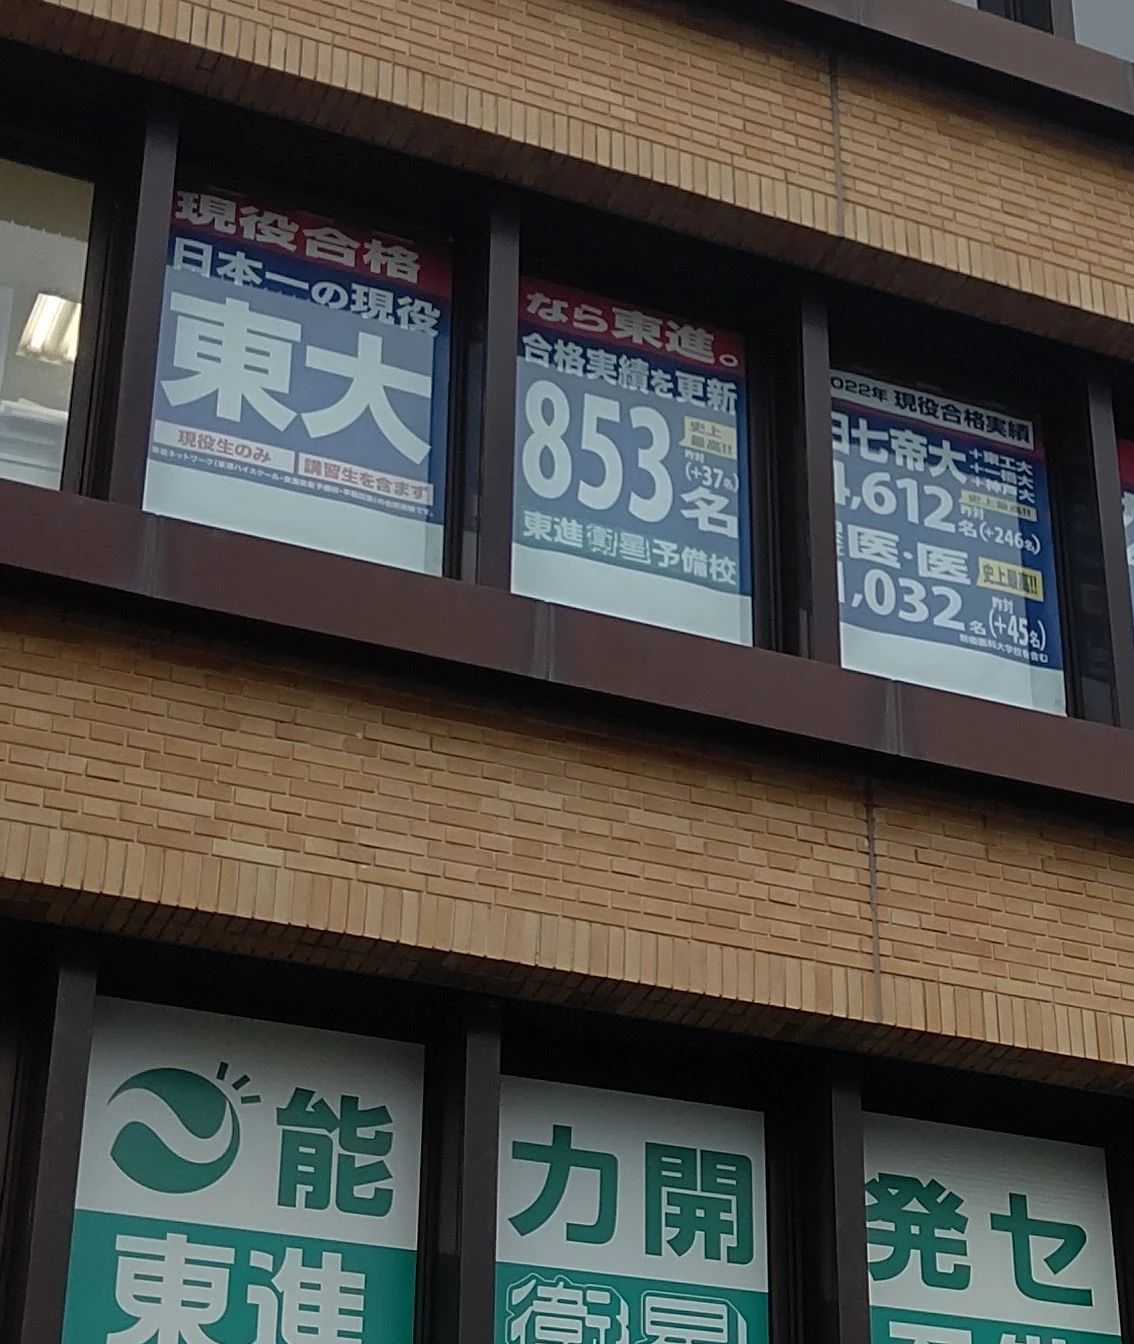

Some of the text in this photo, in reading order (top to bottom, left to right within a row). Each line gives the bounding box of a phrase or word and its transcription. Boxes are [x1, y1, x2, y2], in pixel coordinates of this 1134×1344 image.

[175, 189, 420, 284] 現役合格
[171, 236, 442, 338] 日本一の現役
[526, 292, 738, 367] なら東進。
[161, 291, 432, 465] 東大
[522, 332, 737, 415] 合格実績を更新
[177, 430, 271, 464] 現役生のみ
[894, 389, 1032, 444] 現役合格実績
[522, 509, 737, 585] 東進衛星予備校
